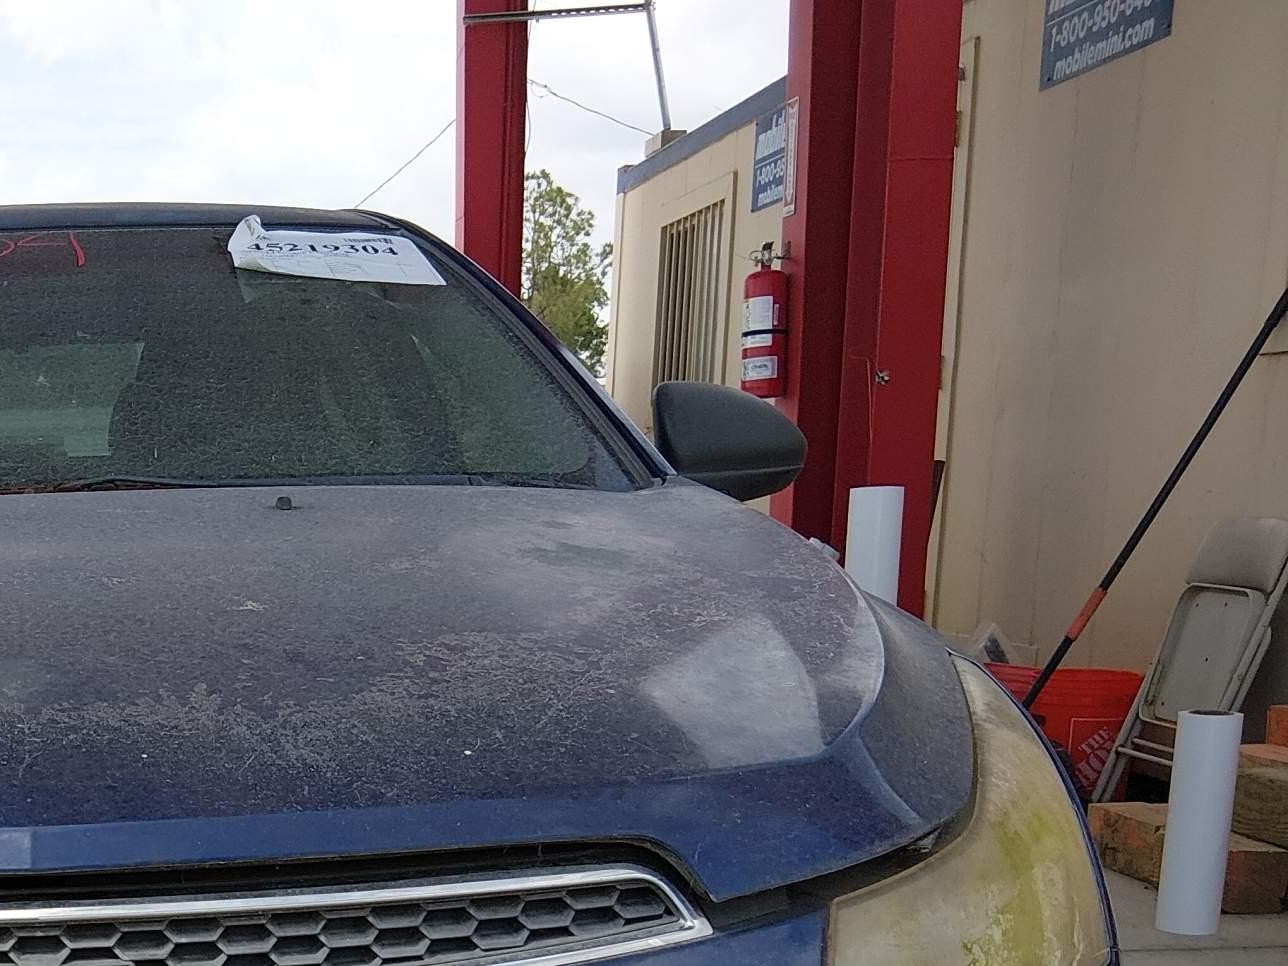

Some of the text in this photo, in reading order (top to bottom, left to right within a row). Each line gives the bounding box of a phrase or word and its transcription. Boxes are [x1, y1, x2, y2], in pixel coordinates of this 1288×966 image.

[1053, 17, 1155, 81] mobilemini.com
[247, 242, 399, 256] 45219304
[1077, 726, 1113, 754] THE
